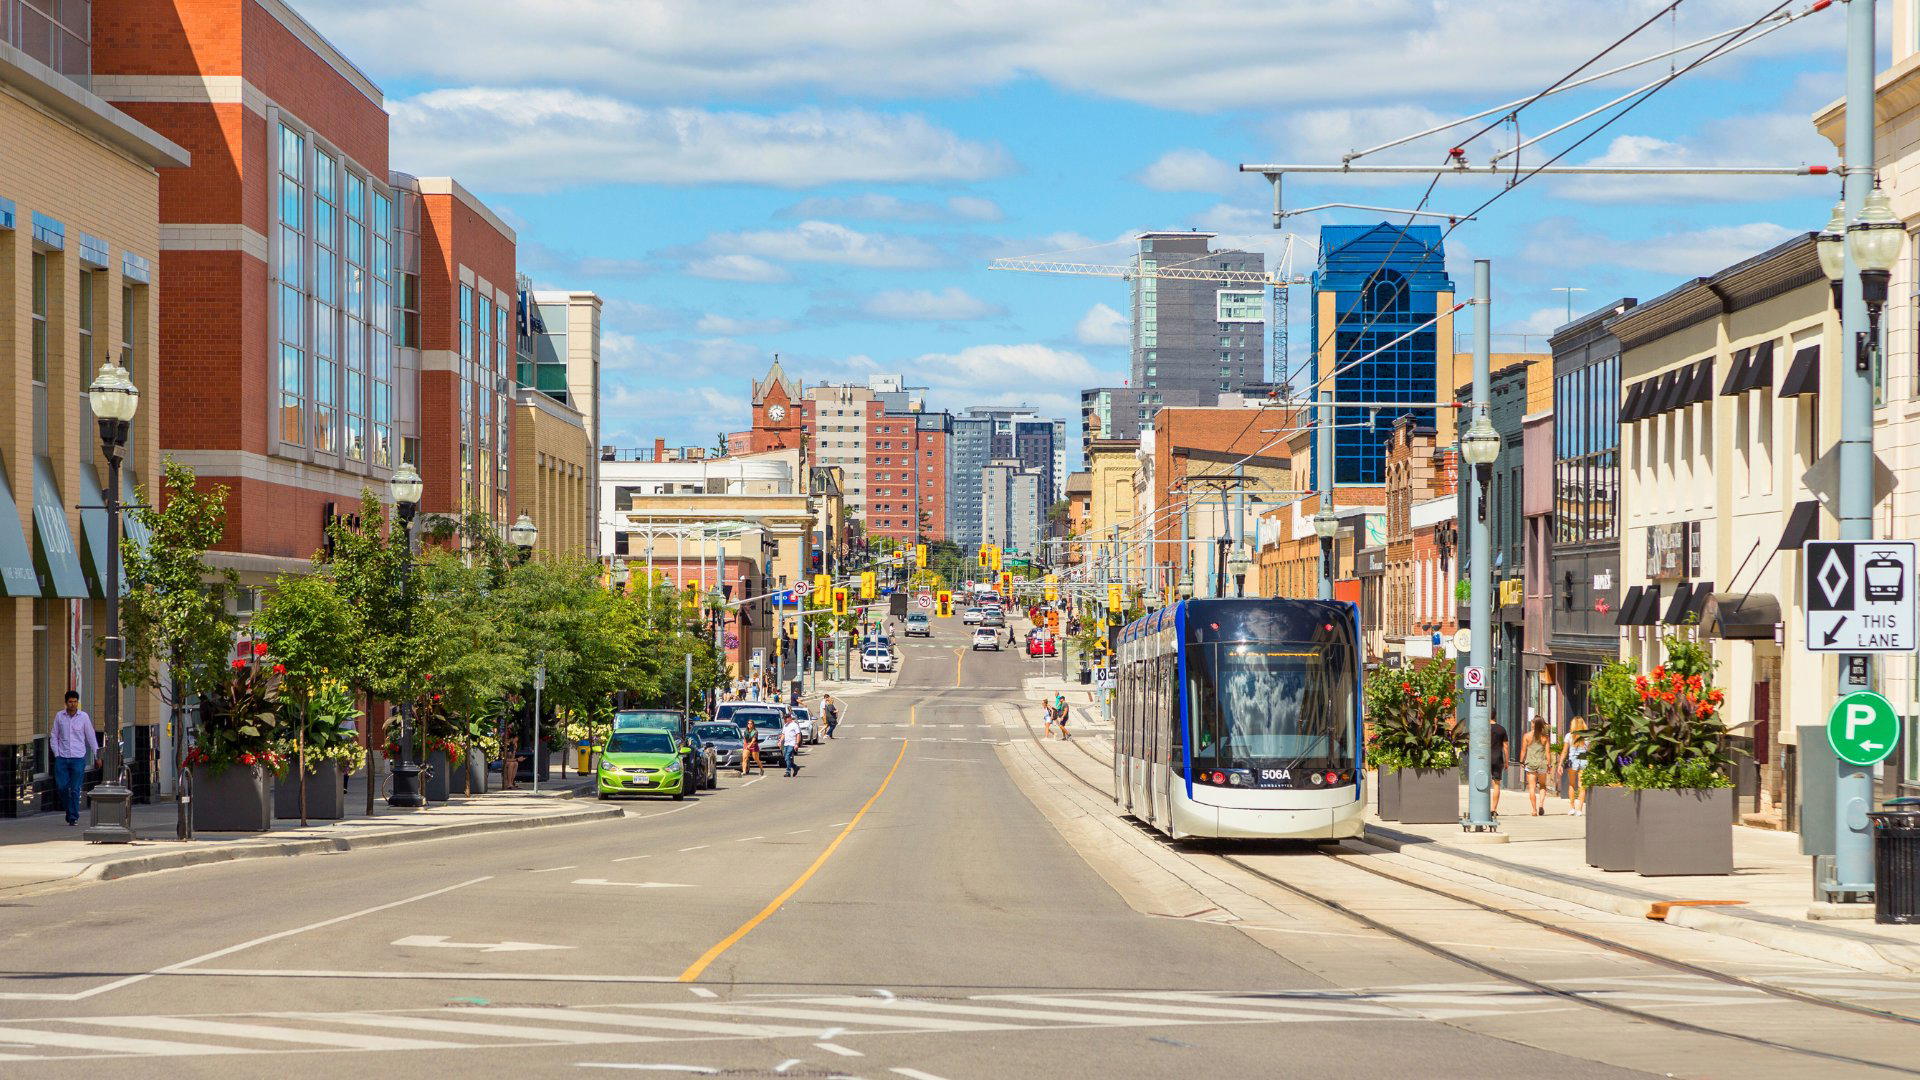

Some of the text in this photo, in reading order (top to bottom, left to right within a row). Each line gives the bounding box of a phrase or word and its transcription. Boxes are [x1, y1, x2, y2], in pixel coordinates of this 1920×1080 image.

[1862, 614, 1896, 629] THIS
[1858, 633, 1900, 647] LANE
[1845, 703, 1877, 740] P
[1261, 769, 1291, 780] 506A
